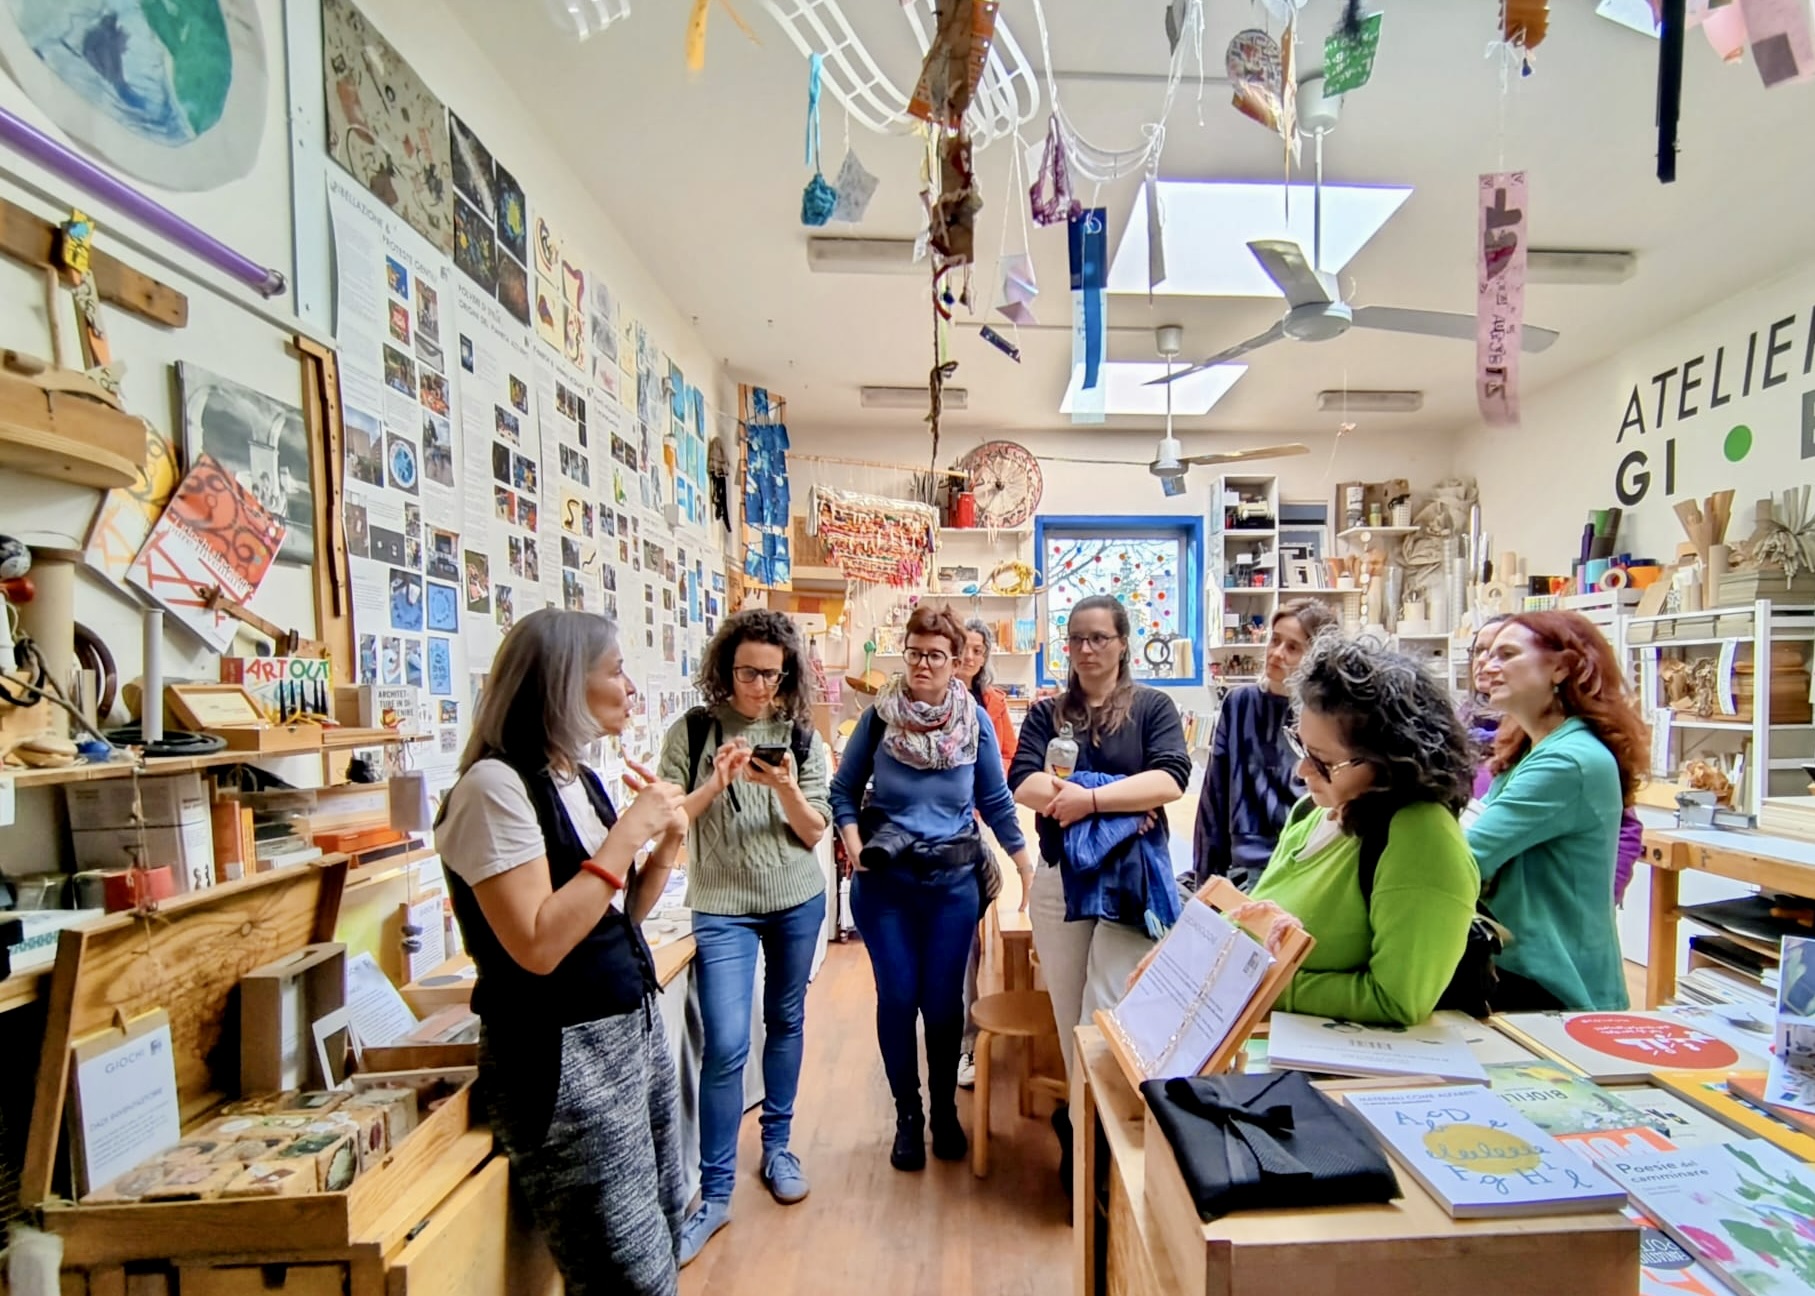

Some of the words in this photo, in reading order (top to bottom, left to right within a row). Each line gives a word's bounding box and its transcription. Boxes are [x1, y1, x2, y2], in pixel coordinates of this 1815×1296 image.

[246, 658, 287, 682] ART
[289, 659, 330, 681] OUT
[104, 1049, 144, 1074] GIOCHI
[1496, 1088, 1568, 1104] BIOFILI
[1615, 1160, 1679, 1175] Poesie
[1630, 1169, 1710, 1183] camminare
